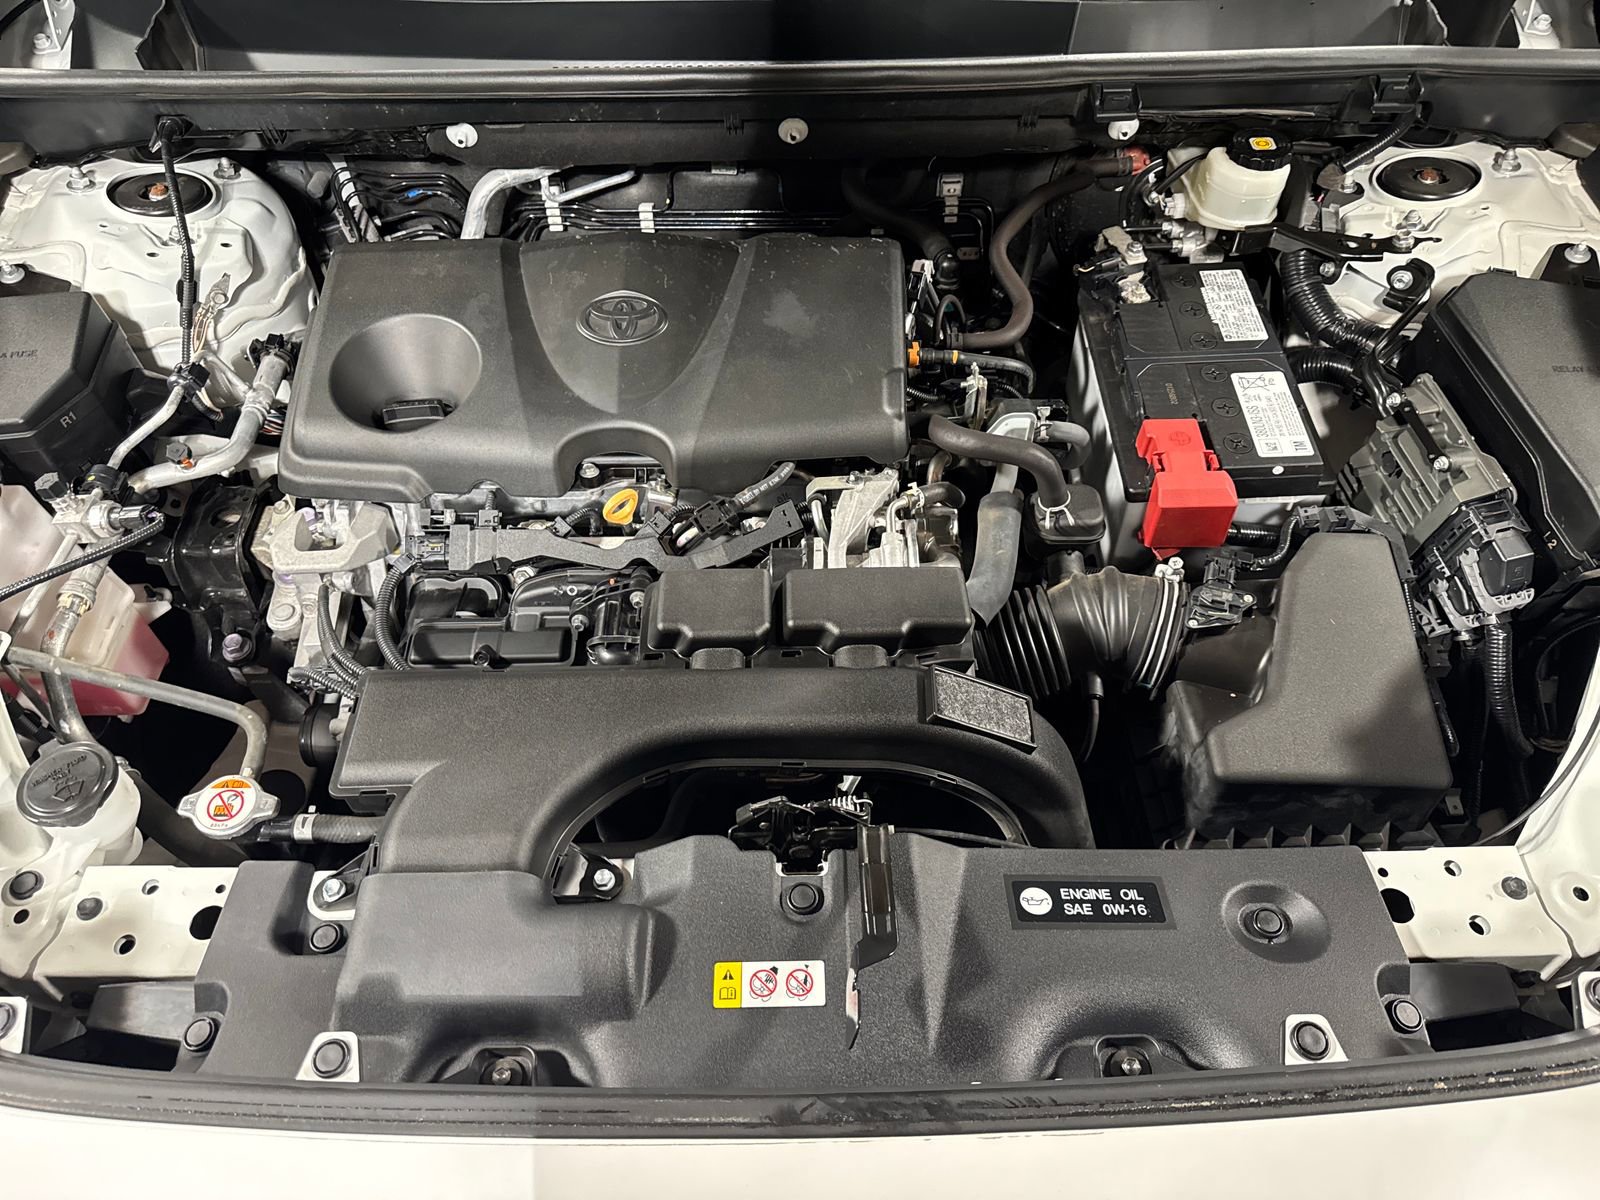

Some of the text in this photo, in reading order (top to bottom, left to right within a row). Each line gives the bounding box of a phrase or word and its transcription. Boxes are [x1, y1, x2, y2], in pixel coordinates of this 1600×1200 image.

[10, 349, 38, 359] FUSE
[60, 411, 77, 428] R1
[1292, 440, 1308, 451] TM
[1543, 531, 1557, 550] L2
[1060, 887, 1145, 901] ENGINE OIL
[1064, 903, 1148, 916] SAE 0W-16
